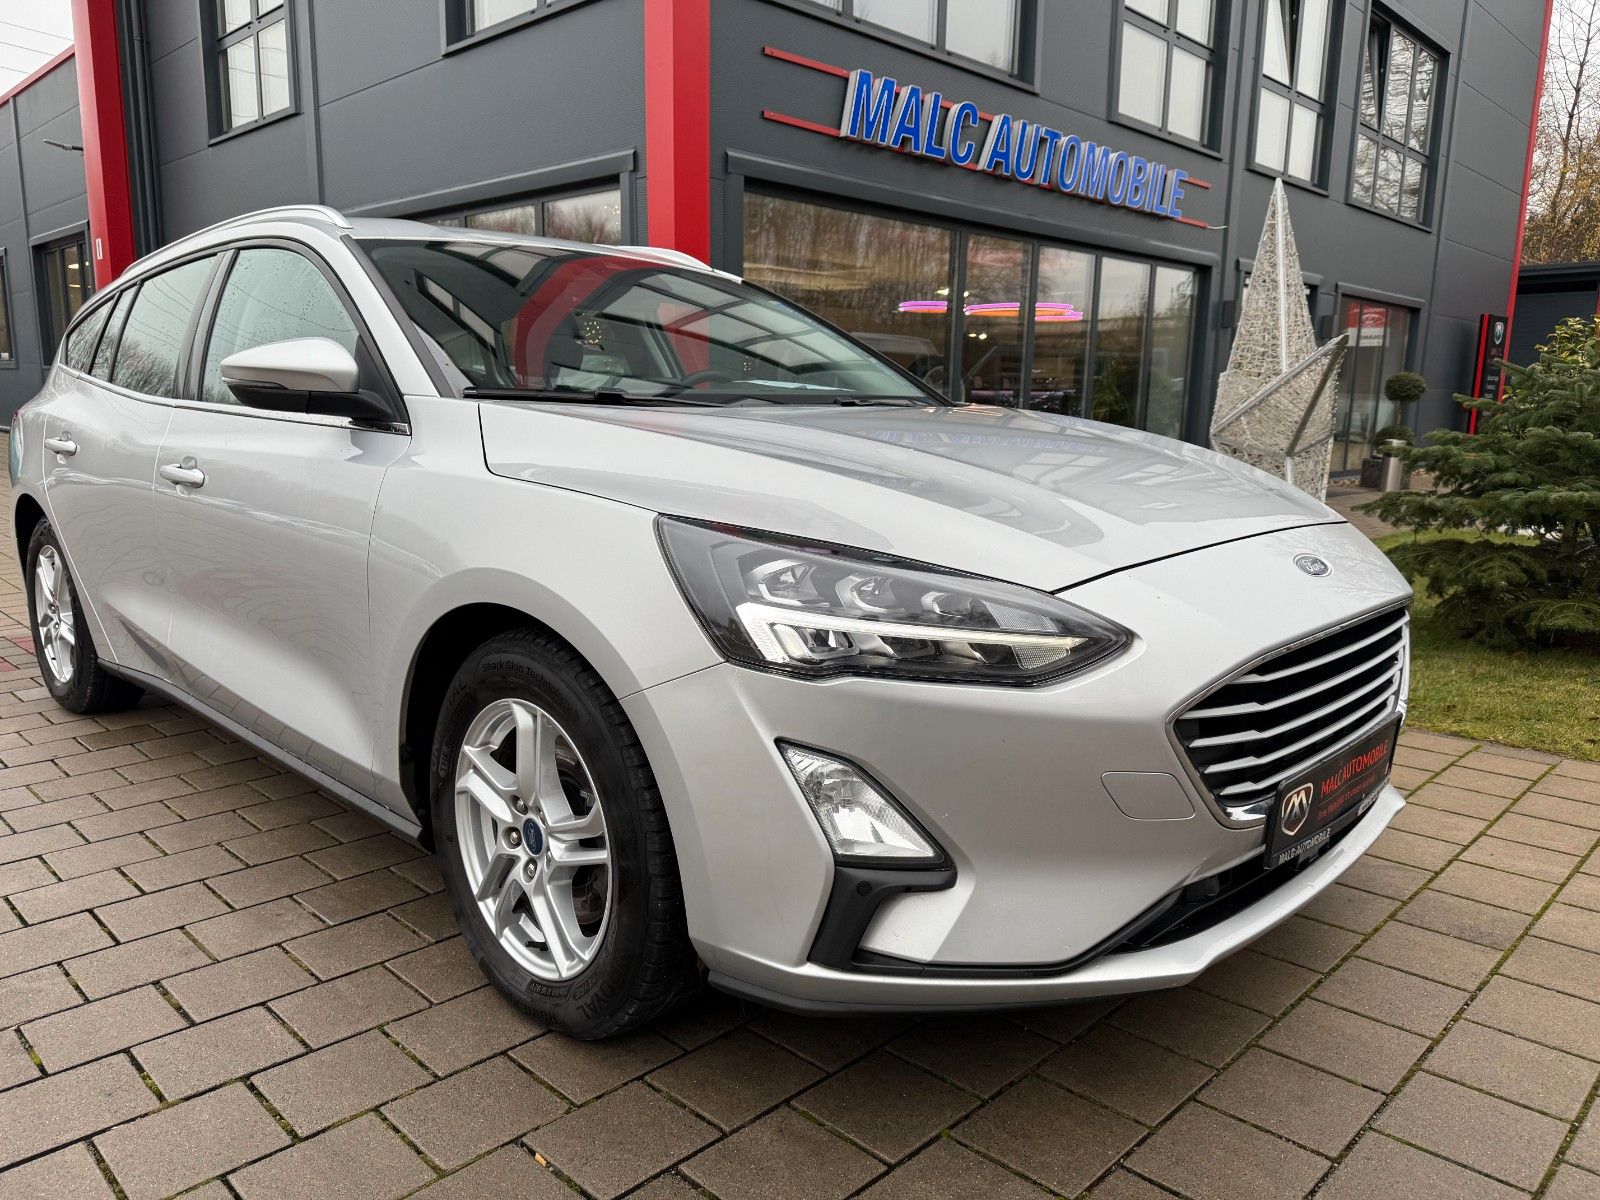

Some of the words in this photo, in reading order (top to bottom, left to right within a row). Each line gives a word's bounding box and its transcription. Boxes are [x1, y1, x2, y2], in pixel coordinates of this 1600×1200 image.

[842, 68, 979, 166] MALC
[978, 113, 1188, 218] AUTOMOBILE
[482, 660, 504, 672] Shark
[505, 660, 524, 673] Skin
[1320, 769, 1343, 799] MALC
[1341, 740, 1389, 783] AUTOMOBILE
